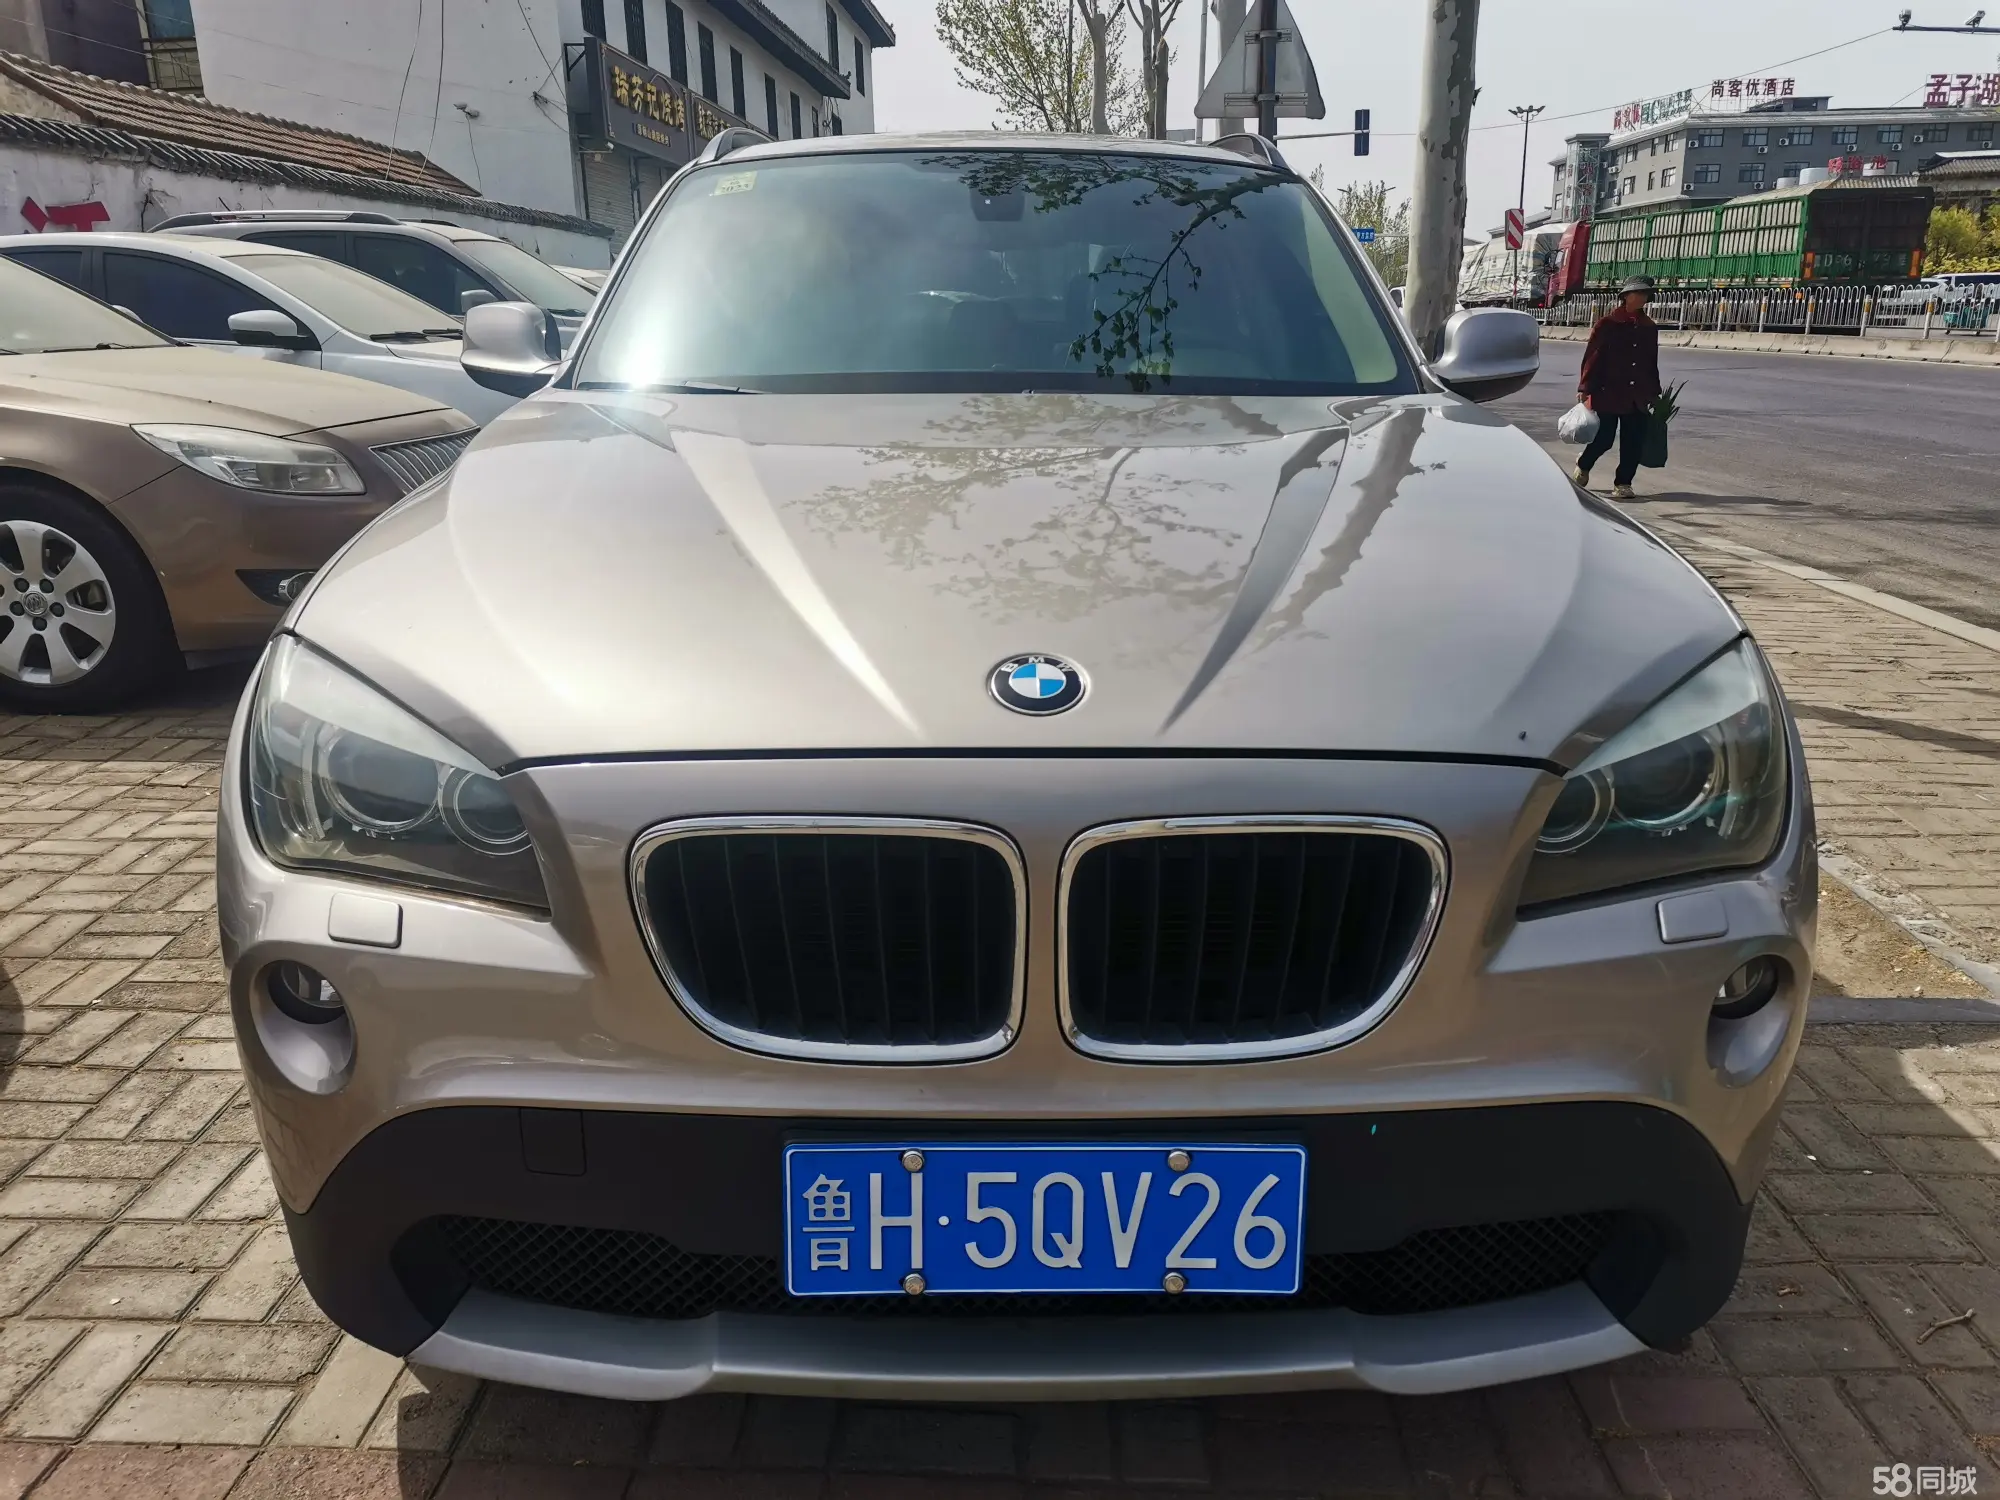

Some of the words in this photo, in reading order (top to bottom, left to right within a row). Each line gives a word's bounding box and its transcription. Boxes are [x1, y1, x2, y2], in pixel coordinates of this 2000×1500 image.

[1711, 78, 1796, 98] 尚客优酒店
[1923, 73, 2000, 108] 孟子湖
[1000, 656, 1074, 673] BMW
[802, 1171, 1287, 1271] 鲁H·5QV26
